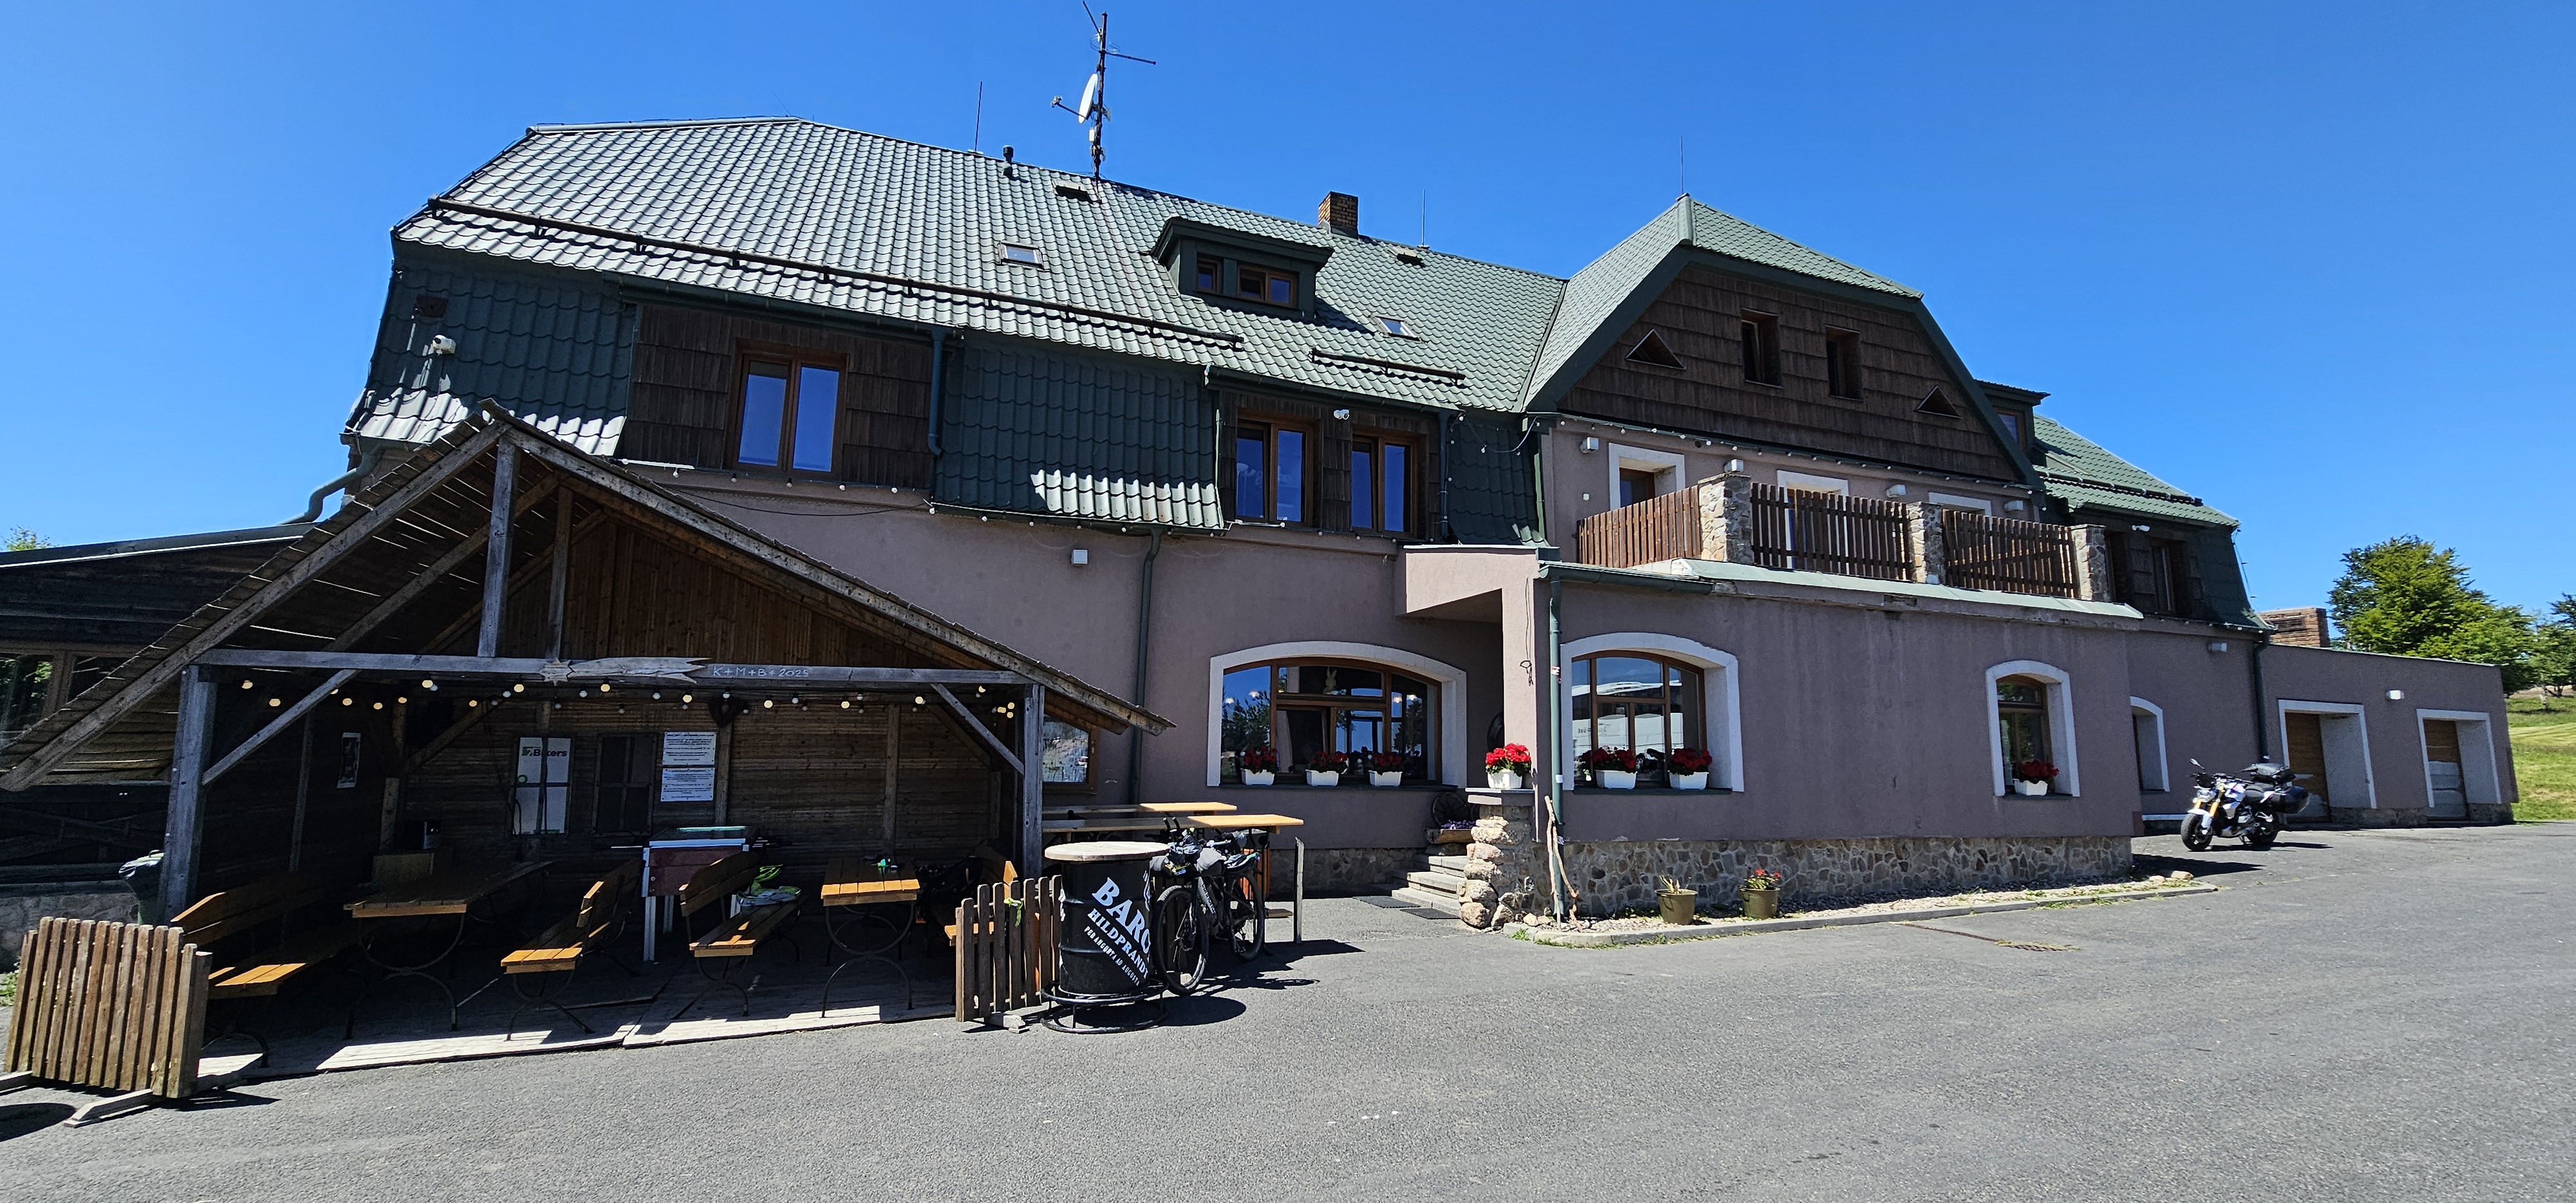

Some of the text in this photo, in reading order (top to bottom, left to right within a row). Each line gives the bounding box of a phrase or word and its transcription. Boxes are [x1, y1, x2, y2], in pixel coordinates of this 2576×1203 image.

[1092, 876, 1151, 963] BARO
[1115, 958, 1123, 966] AD
[1121, 964, 1140, 987] AUGUSTA
